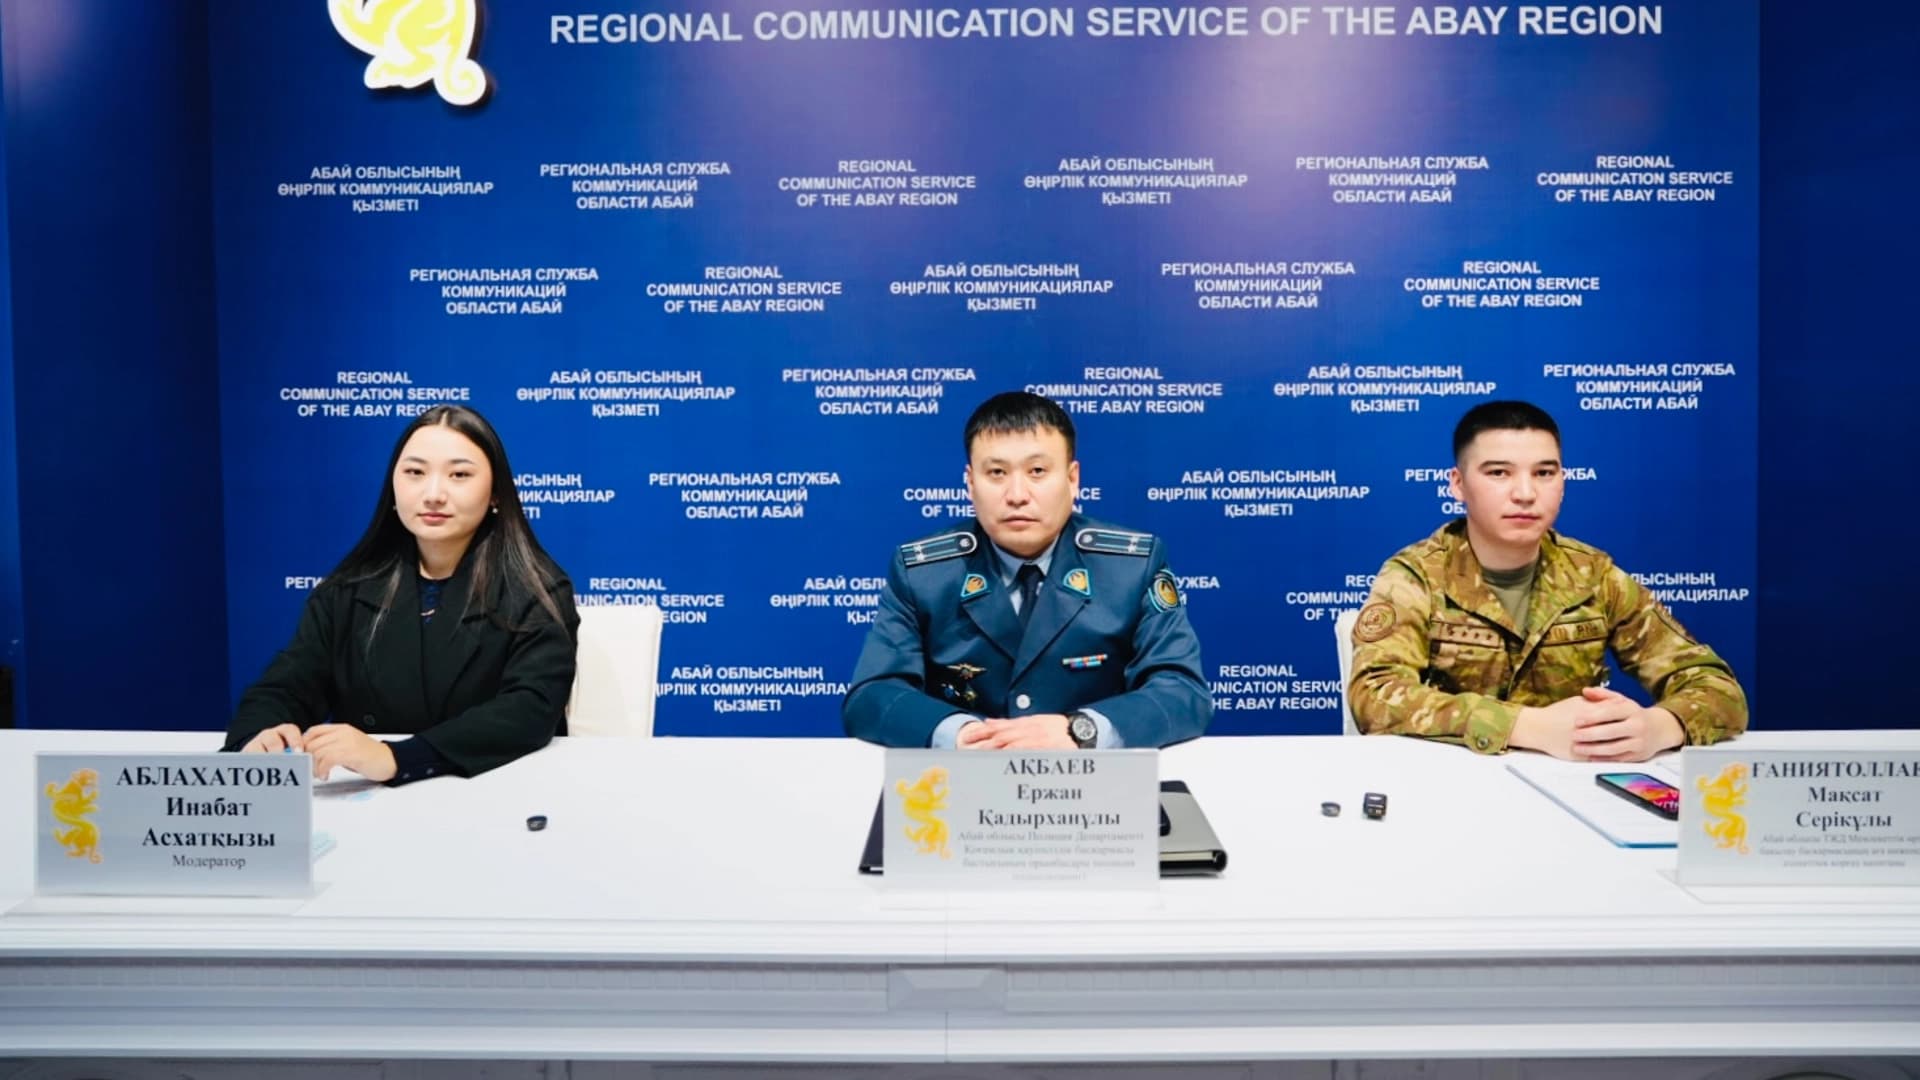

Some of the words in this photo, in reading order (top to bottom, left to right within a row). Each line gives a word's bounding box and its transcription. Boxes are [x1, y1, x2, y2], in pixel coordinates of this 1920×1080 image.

[551, 13, 742, 43] REGIONAL
[753, 8, 1073, 40] COMMUNICATION
[1086, 7, 1248, 36] SERVICE
[1260, 7, 1310, 36] OF
[1328, 7, 1396, 35] THE
[1405, 6, 1507, 35] ABAY
[1518, 5, 1662, 35] REGION
[540, 162, 663, 176] РЕГИОНАЛЬНАЯ
[666, 162, 730, 175] СЛУЖБА
[838, 160, 916, 173] REGIONAL
[1058, 156, 1101, 171] АБАЙ
[1105, 158, 1213, 172] ОБЛЫСЫНЫҢ
[1297, 156, 1421, 169] РЕГИОНАЛЬНАЯ
[1424, 156, 1489, 170] СЛУЖБА
[1596, 156, 1674, 168] REGIONAL
[311, 164, 352, 179] АБАЙ
[355, 166, 461, 180] ОБЛЫСЫНЫҢ
[1329, 170, 1456, 188] КОММУНИКАЦИЙ
[1537, 172, 1665, 186] COMMUNICATION
[1669, 172, 1733, 185] SERVICE
[278, 183, 336, 197] ӨҢІРЛІК
[340, 182, 494, 196] КОММУНИКАЦИЯЛАР
[572, 176, 698, 193] КОММУНИКАЦИЙ
[778, 176, 907, 191] COMMUNICATION
[911, 176, 976, 189] SERVICE
[1024, 175, 1085, 190] ӨҢІРЛІК
[1088, 175, 1247, 189] КОММУНИКАЦИЯЛАР
[576, 196, 648, 209] ОБЛАСТИ
[651, 193, 694, 208] АБАЙ
[796, 193, 818, 207] OF
[821, 193, 851, 206] THE
[854, 193, 896, 206] ABAY
[899, 192, 958, 206] REGION
[1102, 191, 1171, 206] ҚЫЗМЕТІ
[1333, 190, 1406, 202] ОБЛАСТИ
[1409, 187, 1452, 203] АБАЙ
[1555, 189, 1576, 202] OF
[1579, 189, 1610, 202] THE
[1612, 189, 1653, 201] ABAY
[1657, 188, 1715, 201] REGION
[353, 199, 418, 213] ҚЫЗМЕТІ
[410, 268, 532, 281] РЕГИОНАЛЬНАЯ
[535, 268, 599, 281] СЛУЖБА
[705, 266, 783, 279] REGIONAL
[924, 262, 967, 277] АБАЙ
[970, 264, 1080, 278] ОБЛЫСЫНЫҢ
[1161, 262, 1287, 276] РЕГИОНАЛЬНАЯ
[1291, 262, 1356, 275] СЛУЖБА
[1463, 261, 1541, 274] REGIONAL
[442, 282, 566, 299] КОММУНИКАЦИЙ
[646, 283, 773, 296] COMMUNICATION
[777, 282, 842, 295] SERVICE
[890, 281, 950, 296] ӨҢІРЛІК
[954, 280, 1113, 295] КОММУНИКАЦИЯЛАР
[1195, 276, 1322, 293] КОММУНИКАЦИЙ
[1404, 278, 1532, 291] COMMUNICATION
[1536, 277, 1600, 290] SERVICE
[446, 301, 517, 314] ОБЛАСТИ
[520, 299, 562, 314] АБАЙ
[664, 300, 685, 313] OF
[688, 300, 718, 313] THE
[721, 299, 762, 312] ABAY
[765, 299, 824, 312] REGION
[967, 297, 1036, 312] ҚЫЗМЕТІ
[1198, 295, 1272, 309] ОБЛАСТИ
[1275, 293, 1318, 308] АБАЙ
[1422, 294, 1443, 308] OF
[1446, 294, 1476, 308] THE
[1479, 294, 1520, 307] ABAY
[1524, 294, 1582, 307] REGION
[337, 371, 412, 384] REGIONAL
[550, 368, 592, 384] АБАЙ
[595, 371, 702, 385] ОБЛЫСЫНЫҢ
[782, 368, 908, 382] РЕГИОНАЛЬНАЯ
[911, 368, 976, 381] СЛУЖБА
[1084, 367, 1163, 380] REGIONAL
[1308, 363, 1351, 379] АБАЙ
[1354, 365, 1463, 380] ОБЛЫСЫНЫҢ
[1544, 364, 1668, 377] РЕГИОНАЛЬНАЯ
[1671, 363, 1735, 376] СЛУЖБА
[815, 382, 943, 399] КОММУНИКАЦИЙ
[1157, 383, 1223, 396] SERVICE
[1273, 383, 1334, 398] ӨҢІРЛІК
[1337, 382, 1496, 396] КОММУНИКАЦИЯЛАР
[1576, 378, 1703, 394] КОММУНИКАЦИЙ
[280, 388, 403, 400] COMMUNICATION
[407, 388, 470, 400] SERVICE
[516, 387, 575, 402] ӨҢІРЛІК
[579, 386, 735, 401] КОММУНИКАЦИЯЛАР
[819, 401, 892, 415] ОБЛАСТИ
[896, 399, 938, 414] АБАЙ
[1067, 400, 1098, 413] THE
[1100, 400, 1142, 413] ABAY
[1145, 400, 1204, 413] REGION
[1351, 399, 1419, 414] ҚЫЗМЕТІ
[1580, 397, 1652, 410] ОБЛАСТИ
[1656, 394, 1698, 409] АБАЙ
[298, 404, 317, 417] OF
[322, 404, 350, 416] THE
[353, 404, 392, 416] ABAY
[592, 403, 659, 418] ҚЫЗМЕТІ
[513, 473, 582, 488] ЫСЫНЫҢ
[649, 473, 773, 486] РЕГИОНАЛЬНАЯ
[776, 472, 840, 485] СЛУЖБА
[1181, 468, 1224, 484] АБАЙ
[1228, 470, 1336, 484] ОБЛЫСЫНЫҢ
[681, 486, 808, 503] КОММУНИКАЦИЙ
[1147, 487, 1207, 502] ӨҢІРЛІК
[1212, 486, 1370, 501] КОММУНИКАЦИЯЛАР
[686, 506, 758, 519] ОБЛАСТИ
[761, 503, 803, 518] АБАЙ
[922, 505, 942, 517] OF
[1225, 503, 1293, 518] ҚЫЗМЕТІ
[590, 578, 666, 591] REGIONAL
[804, 575, 846, 590] АБАЙ
[1175, 576, 1221, 589] УЖБА
[661, 594, 725, 607] SERVICE
[770, 594, 830, 609] ӨҢІРЛІК
[1286, 591, 1369, 605] COMMUNIC
[662, 611, 707, 624] EGION
[1304, 608, 1325, 621] OF
[671, 665, 713, 679] АБАЙ
[716, 667, 823, 681] ОБЛЫСЫНЫҢ
[1219, 665, 1298, 678] REGIONAL
[1208, 681, 1288, 694] UNICATION
[1291, 680, 1343, 693] SERVIC
[714, 699, 781, 713] ҚЫЗМЕТІ
[1212, 698, 1232, 710] HE
[1235, 697, 1276, 710] ABAY
[1279, 697, 1338, 710] REGION
[116, 766, 300, 787] АБЛАХАТОВА
[166, 797, 252, 816] Инабат
[142, 827, 276, 848] Асхатқызы
[172, 855, 246, 869] Модератор
